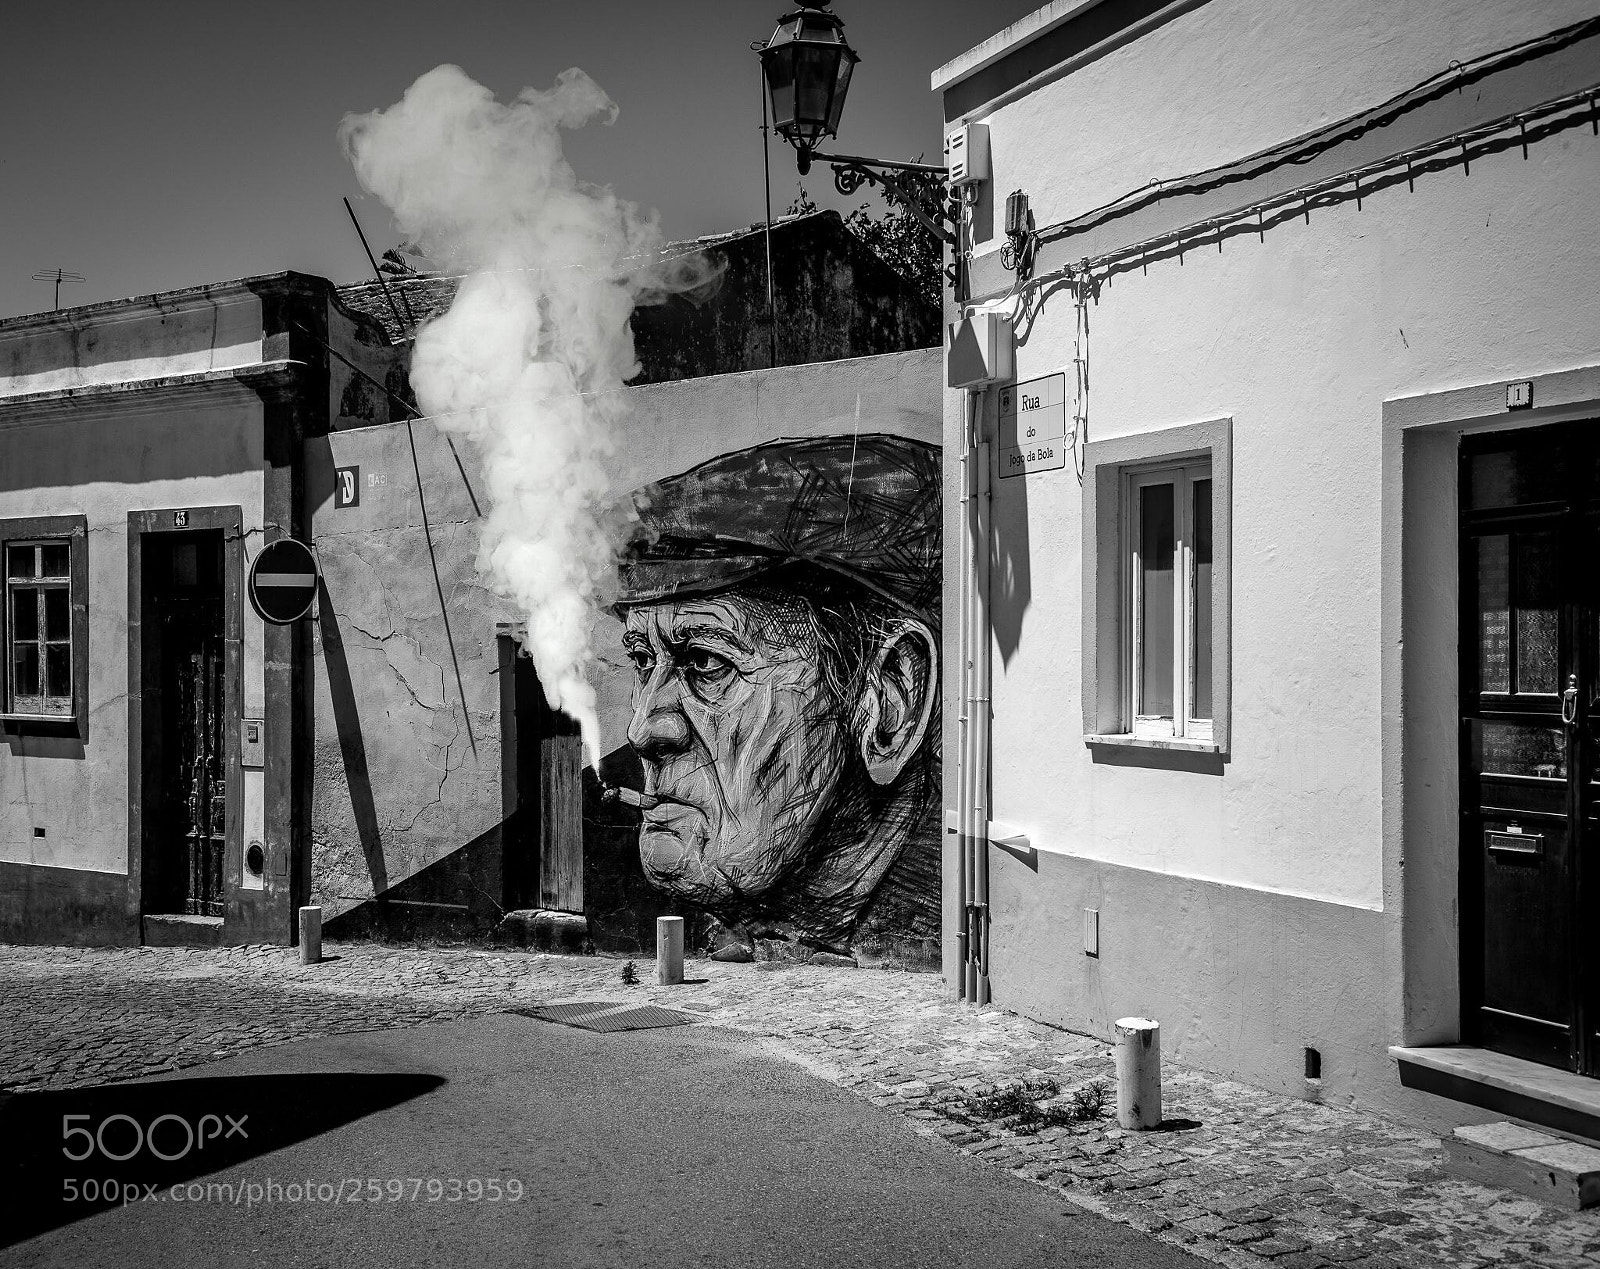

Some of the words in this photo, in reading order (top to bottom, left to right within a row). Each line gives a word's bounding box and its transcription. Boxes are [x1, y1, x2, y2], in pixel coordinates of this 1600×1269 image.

[1021, 394, 1041, 411] Rua
[1026, 426, 1036, 438] do
[1009, 453, 1025, 468] Jogo
[1026, 450, 1036, 463] da
[1037, 447, 1054, 461] Bola
